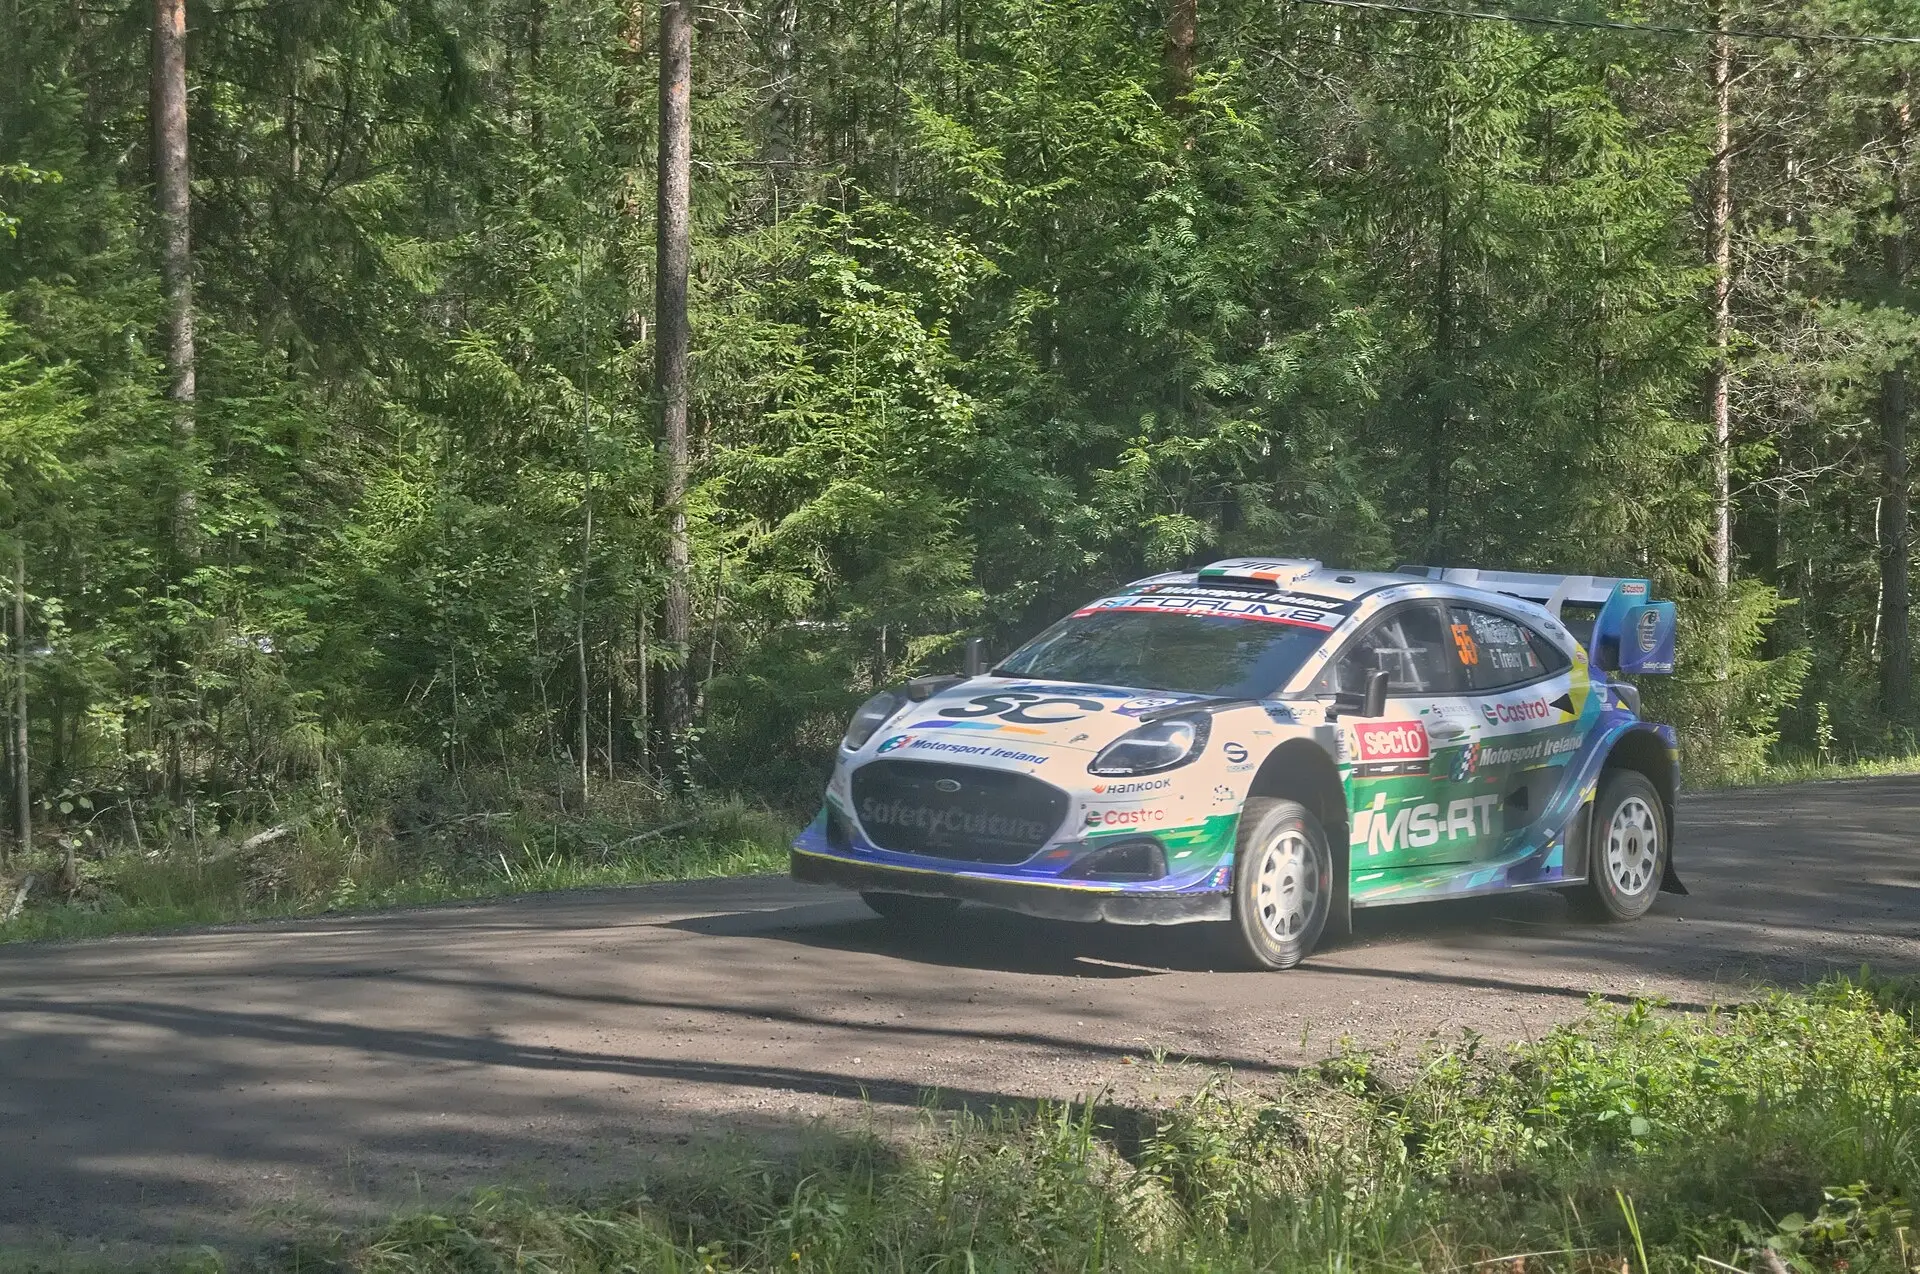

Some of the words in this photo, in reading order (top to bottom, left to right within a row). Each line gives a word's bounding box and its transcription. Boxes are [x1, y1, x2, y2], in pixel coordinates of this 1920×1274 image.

[1157, 585, 1265, 599] Motorsport
[1265, 592, 1344, 610] Ireland
[938, 693, 1105, 724] SC
[1496, 696, 1550, 723] Castrol
[910, 739, 990, 758] Motorsport
[990, 748, 1049, 765] Ireland
[1363, 726, 1422, 755] secto
[1479, 741, 1542, 766] Motorsport
[1543, 732, 1584, 756] Ireland
[1104, 807, 1166, 825] Castro
